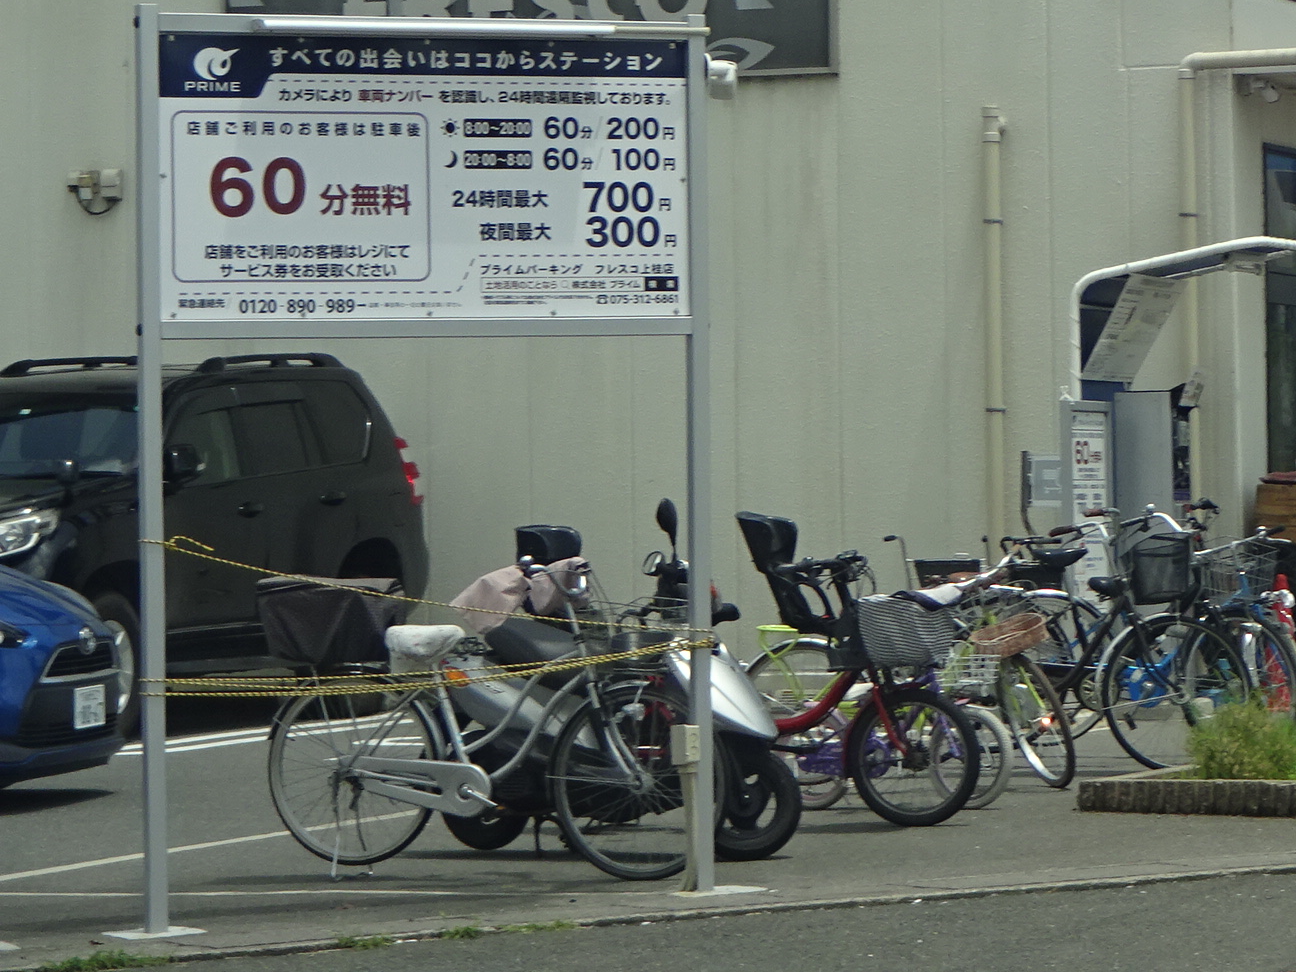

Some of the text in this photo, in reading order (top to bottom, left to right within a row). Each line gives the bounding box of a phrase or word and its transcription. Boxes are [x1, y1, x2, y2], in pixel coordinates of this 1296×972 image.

[269, 46, 663, 71] すべての出会いはココからステーション
[184, 81, 241, 92] PRIME
[279, 88, 352, 103] カメラにより
[358, 89, 434, 103] 車両ナンバー
[187, 120, 421, 137] 店舗ご利用のお客様は駐車後
[452, 189, 549, 208] 24時間最大
[479, 222, 552, 241] 夜間最大
[204, 244, 411, 260] 店舗をご利用のお客様はレジにて
[219, 263, 397, 278] サービス券をお受取ください
